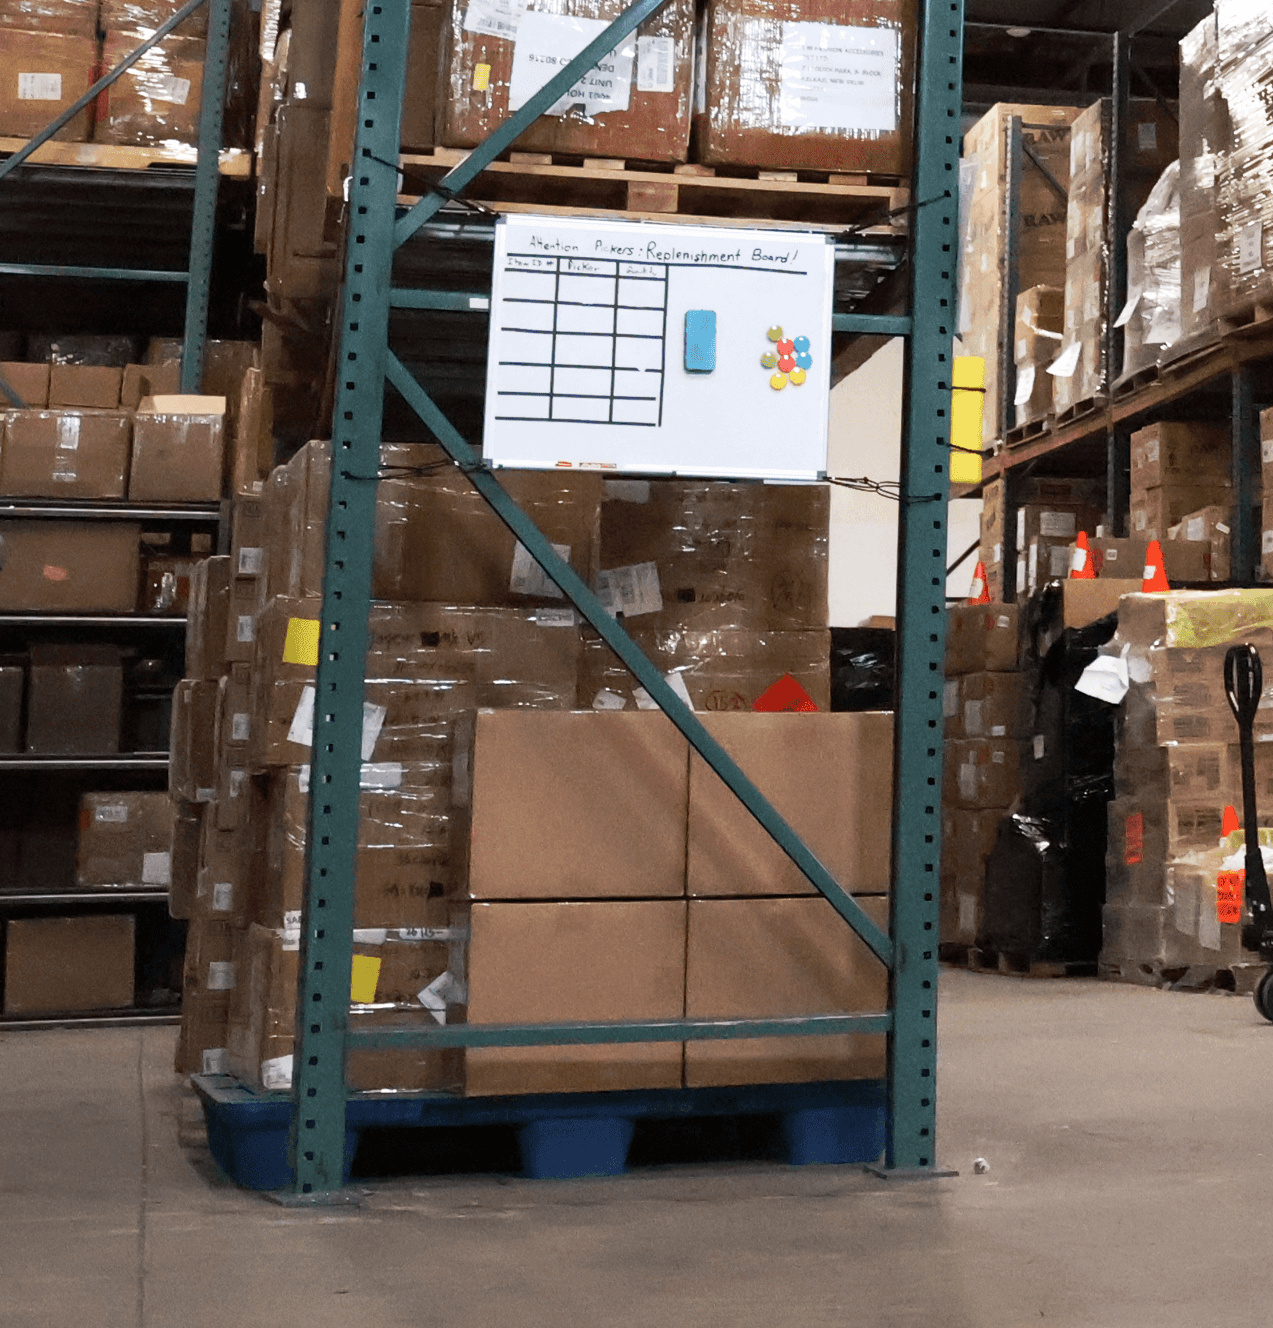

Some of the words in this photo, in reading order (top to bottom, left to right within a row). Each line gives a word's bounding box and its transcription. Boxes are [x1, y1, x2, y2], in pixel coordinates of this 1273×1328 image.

[589, 79, 612, 88] UNIT
[529, 235, 579, 251] Attention
[647, 241, 741, 262] Replenishment
[751, 248, 798, 264] Board!
